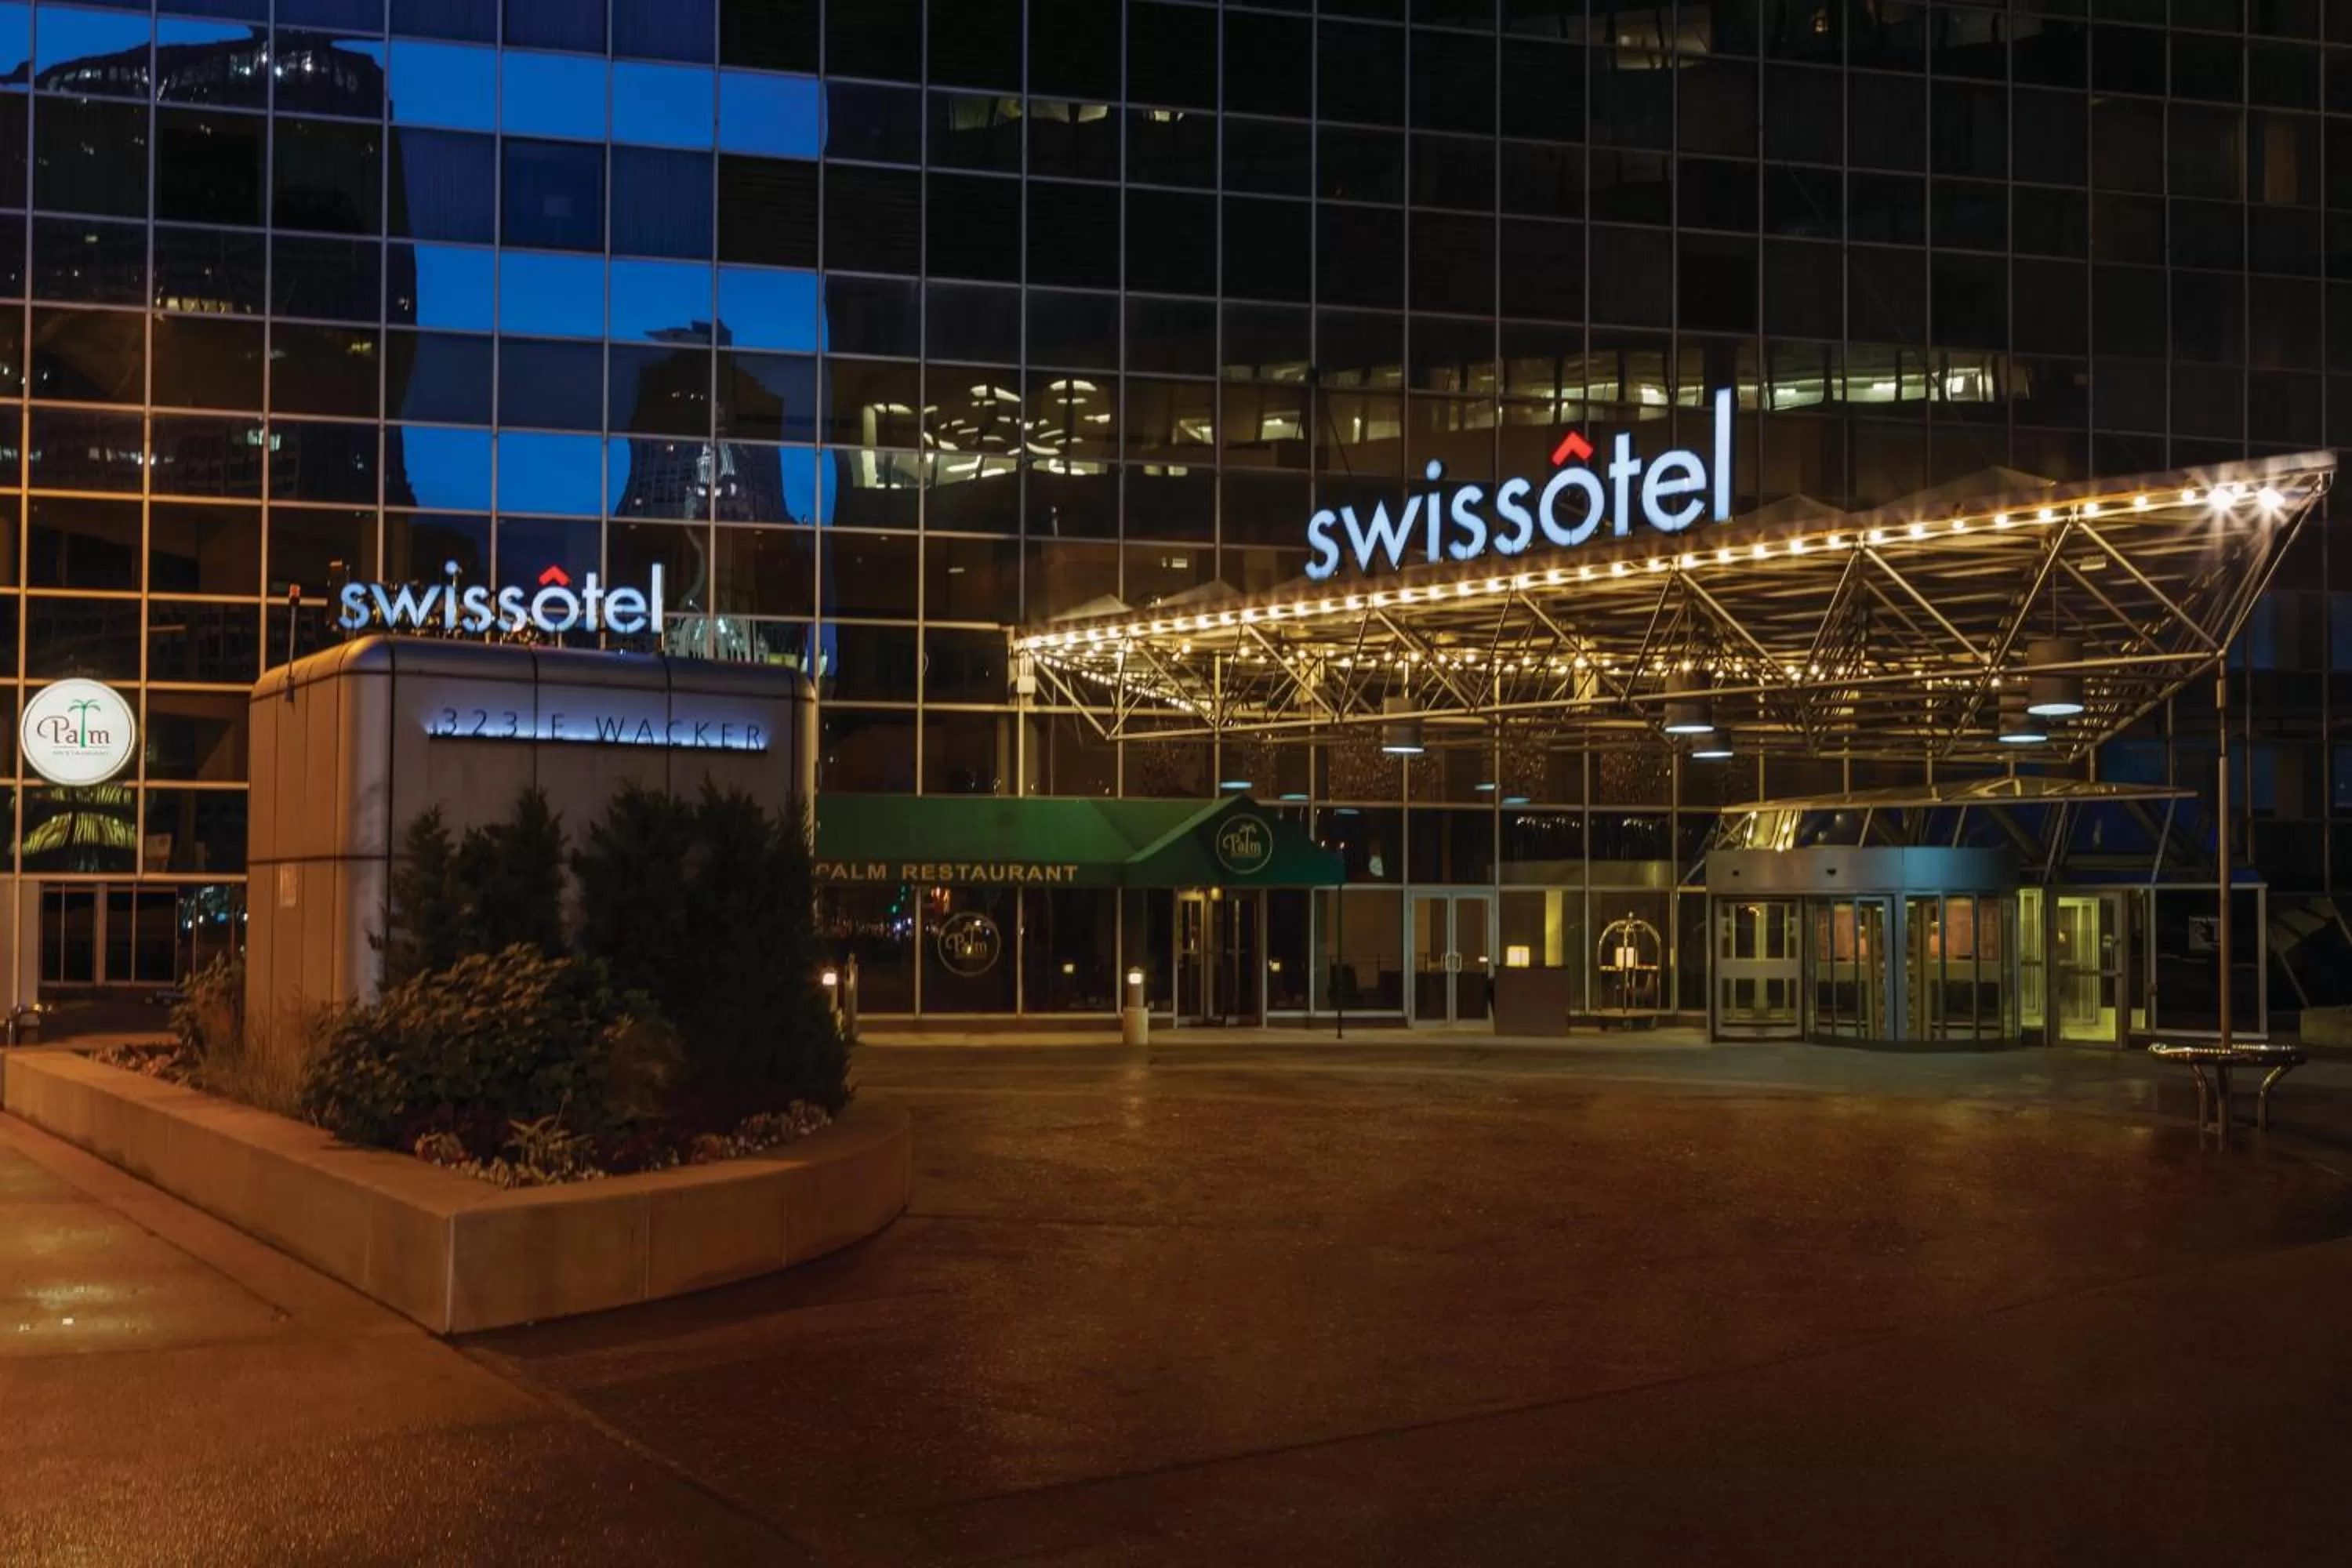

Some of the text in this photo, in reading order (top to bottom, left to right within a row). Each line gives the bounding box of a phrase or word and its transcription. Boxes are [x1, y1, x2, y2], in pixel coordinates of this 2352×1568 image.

[1305, 387, 1731, 581] swissôtel
[338, 560, 665, 633] swissôtel
[37, 698, 111, 748] Palm
[443, 708, 518, 739] 323
[595, 716, 760, 750] WACKER
[902, 865, 1079, 881] RESTAURANT
